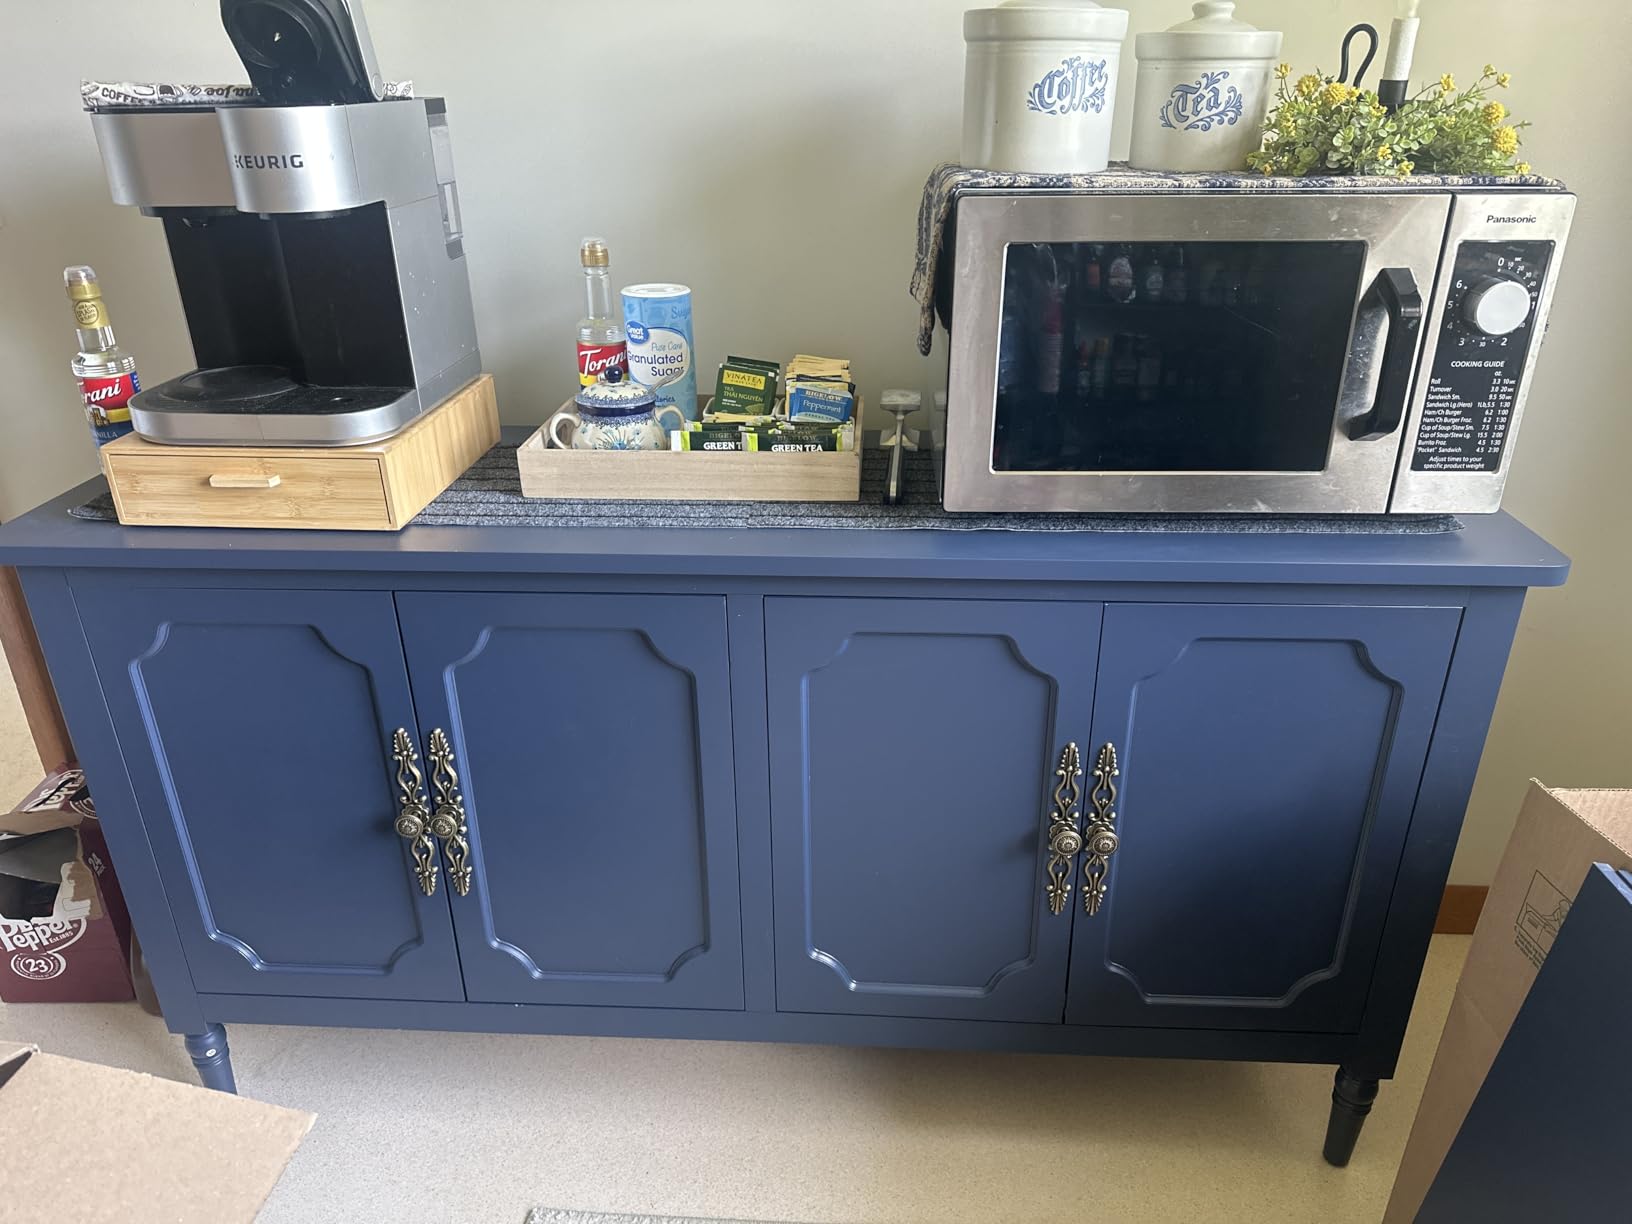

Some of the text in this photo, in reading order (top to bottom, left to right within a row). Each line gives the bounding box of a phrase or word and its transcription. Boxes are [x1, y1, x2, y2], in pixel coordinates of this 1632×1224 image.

[1033, 57, 1108, 114] Coffee
[1171, 81, 1221, 124] Tea
[234, 154, 304, 169] KEURIG
[1486, 215, 1537, 224] Panasonic
[1498, 257, 1505, 266] 0
[1456, 280, 1463, 288] 6
[1447, 300, 1454, 309] 5
[1530, 302, 1536, 310] 1
[626, 324, 644, 336] Great
[1458, 338, 1466, 346] 3
[1500, 338, 1508, 346] 2
[726, 371, 763, 385] VINATEA
[803, 399, 842, 413] Peppermint
[703, 441, 735, 450] GREEN
[771, 444, 823, 452] GREEN TEA
[25, 958, 48, 973] 23
